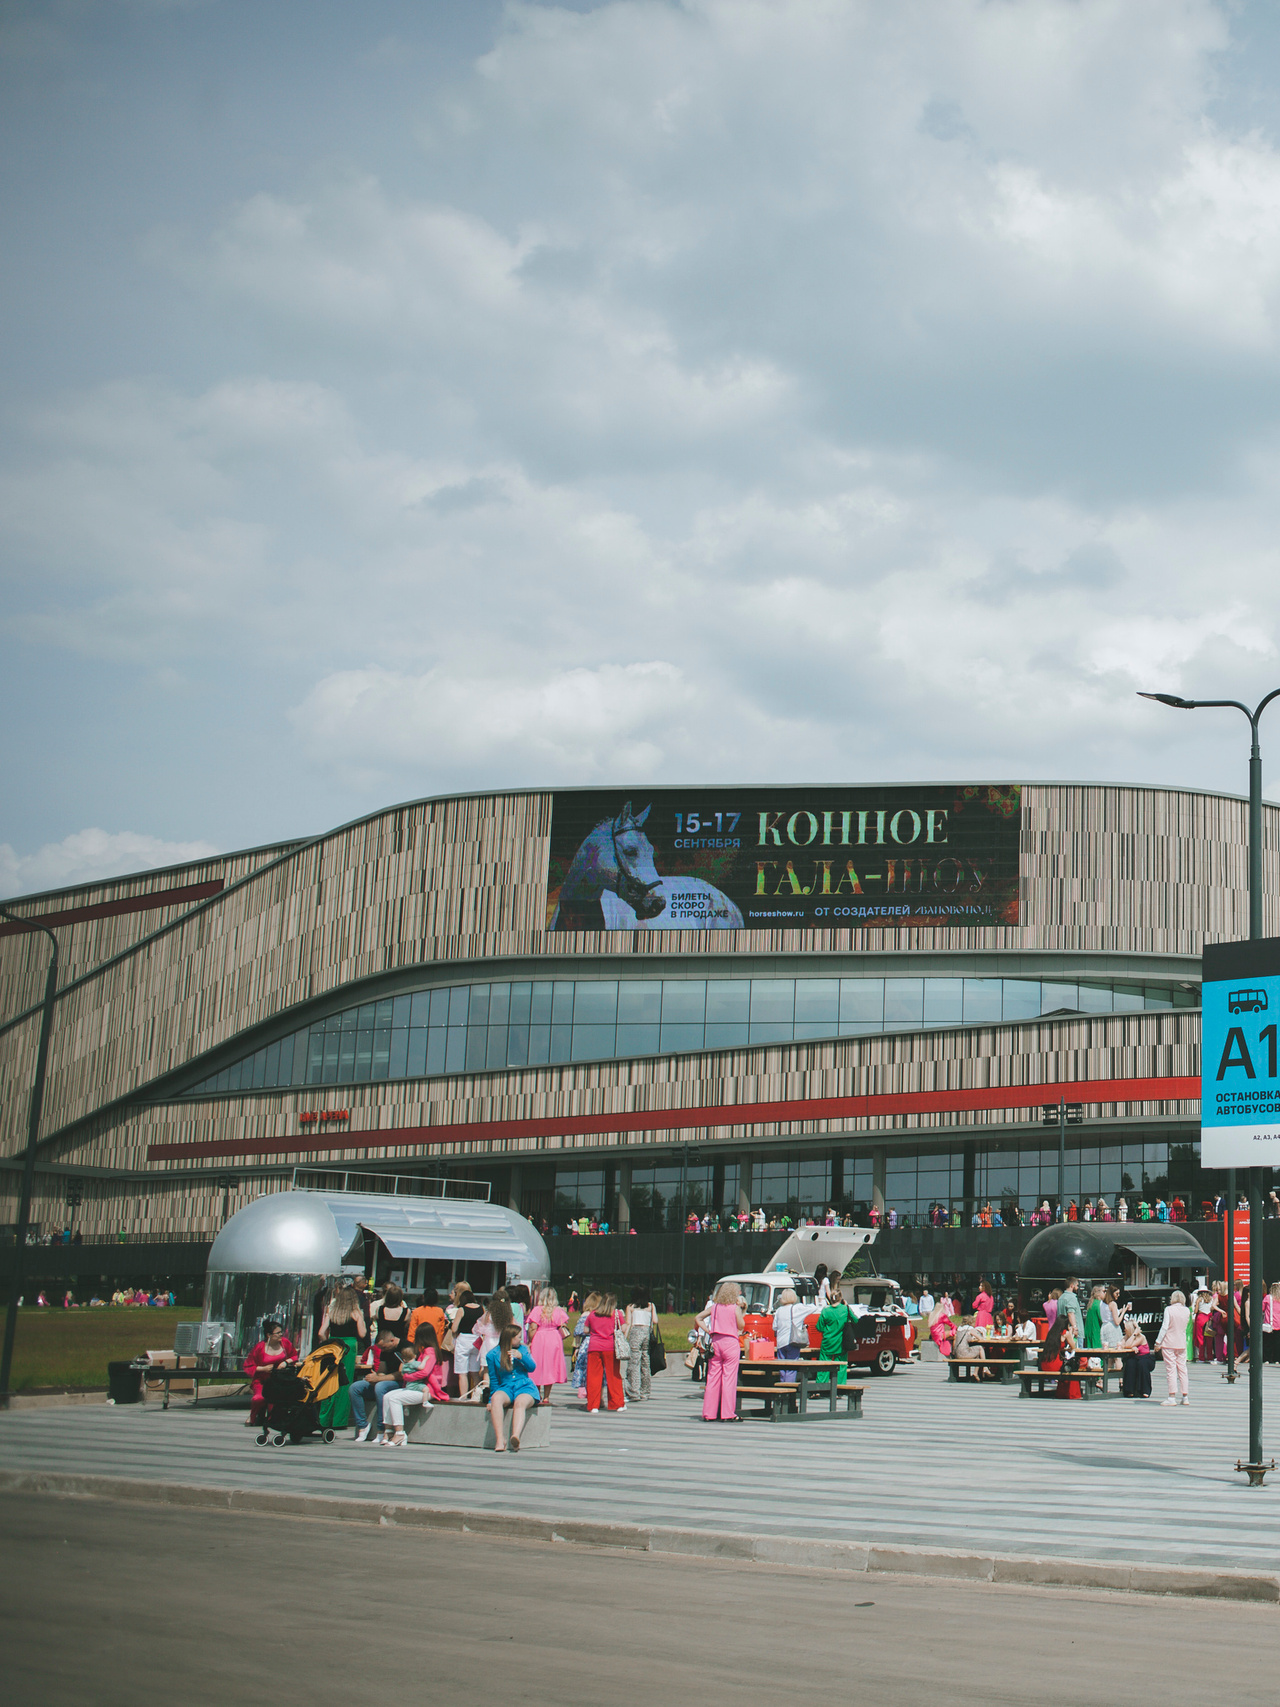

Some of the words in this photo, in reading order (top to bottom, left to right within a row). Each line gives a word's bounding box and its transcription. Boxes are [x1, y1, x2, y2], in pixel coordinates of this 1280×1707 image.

[674, 812, 742, 833] 15-17
[755, 809, 949, 846] КОННОЕ
[674, 838, 741, 848] СЕНТЯБРЯ
[753, 857, 996, 895] ГАЛА-ШОУ
[671, 892, 711, 901] БИЛЕТЫ
[670, 901, 705, 910] СКОРО
[814, 906, 830, 917] ОТ
[833, 904, 911, 917] СОЗДАТЕЛЕЙ
[670, 910, 677, 918] В
[680, 910, 729, 919] ПРОДАЖЕ
[749, 909, 805, 917] horseshow.ru
[1216, 1090, 1280, 1103] ОСТАНОВКА
[1124, 1312, 1153, 1324] SMART
[861, 1334, 882, 1344] FEST
